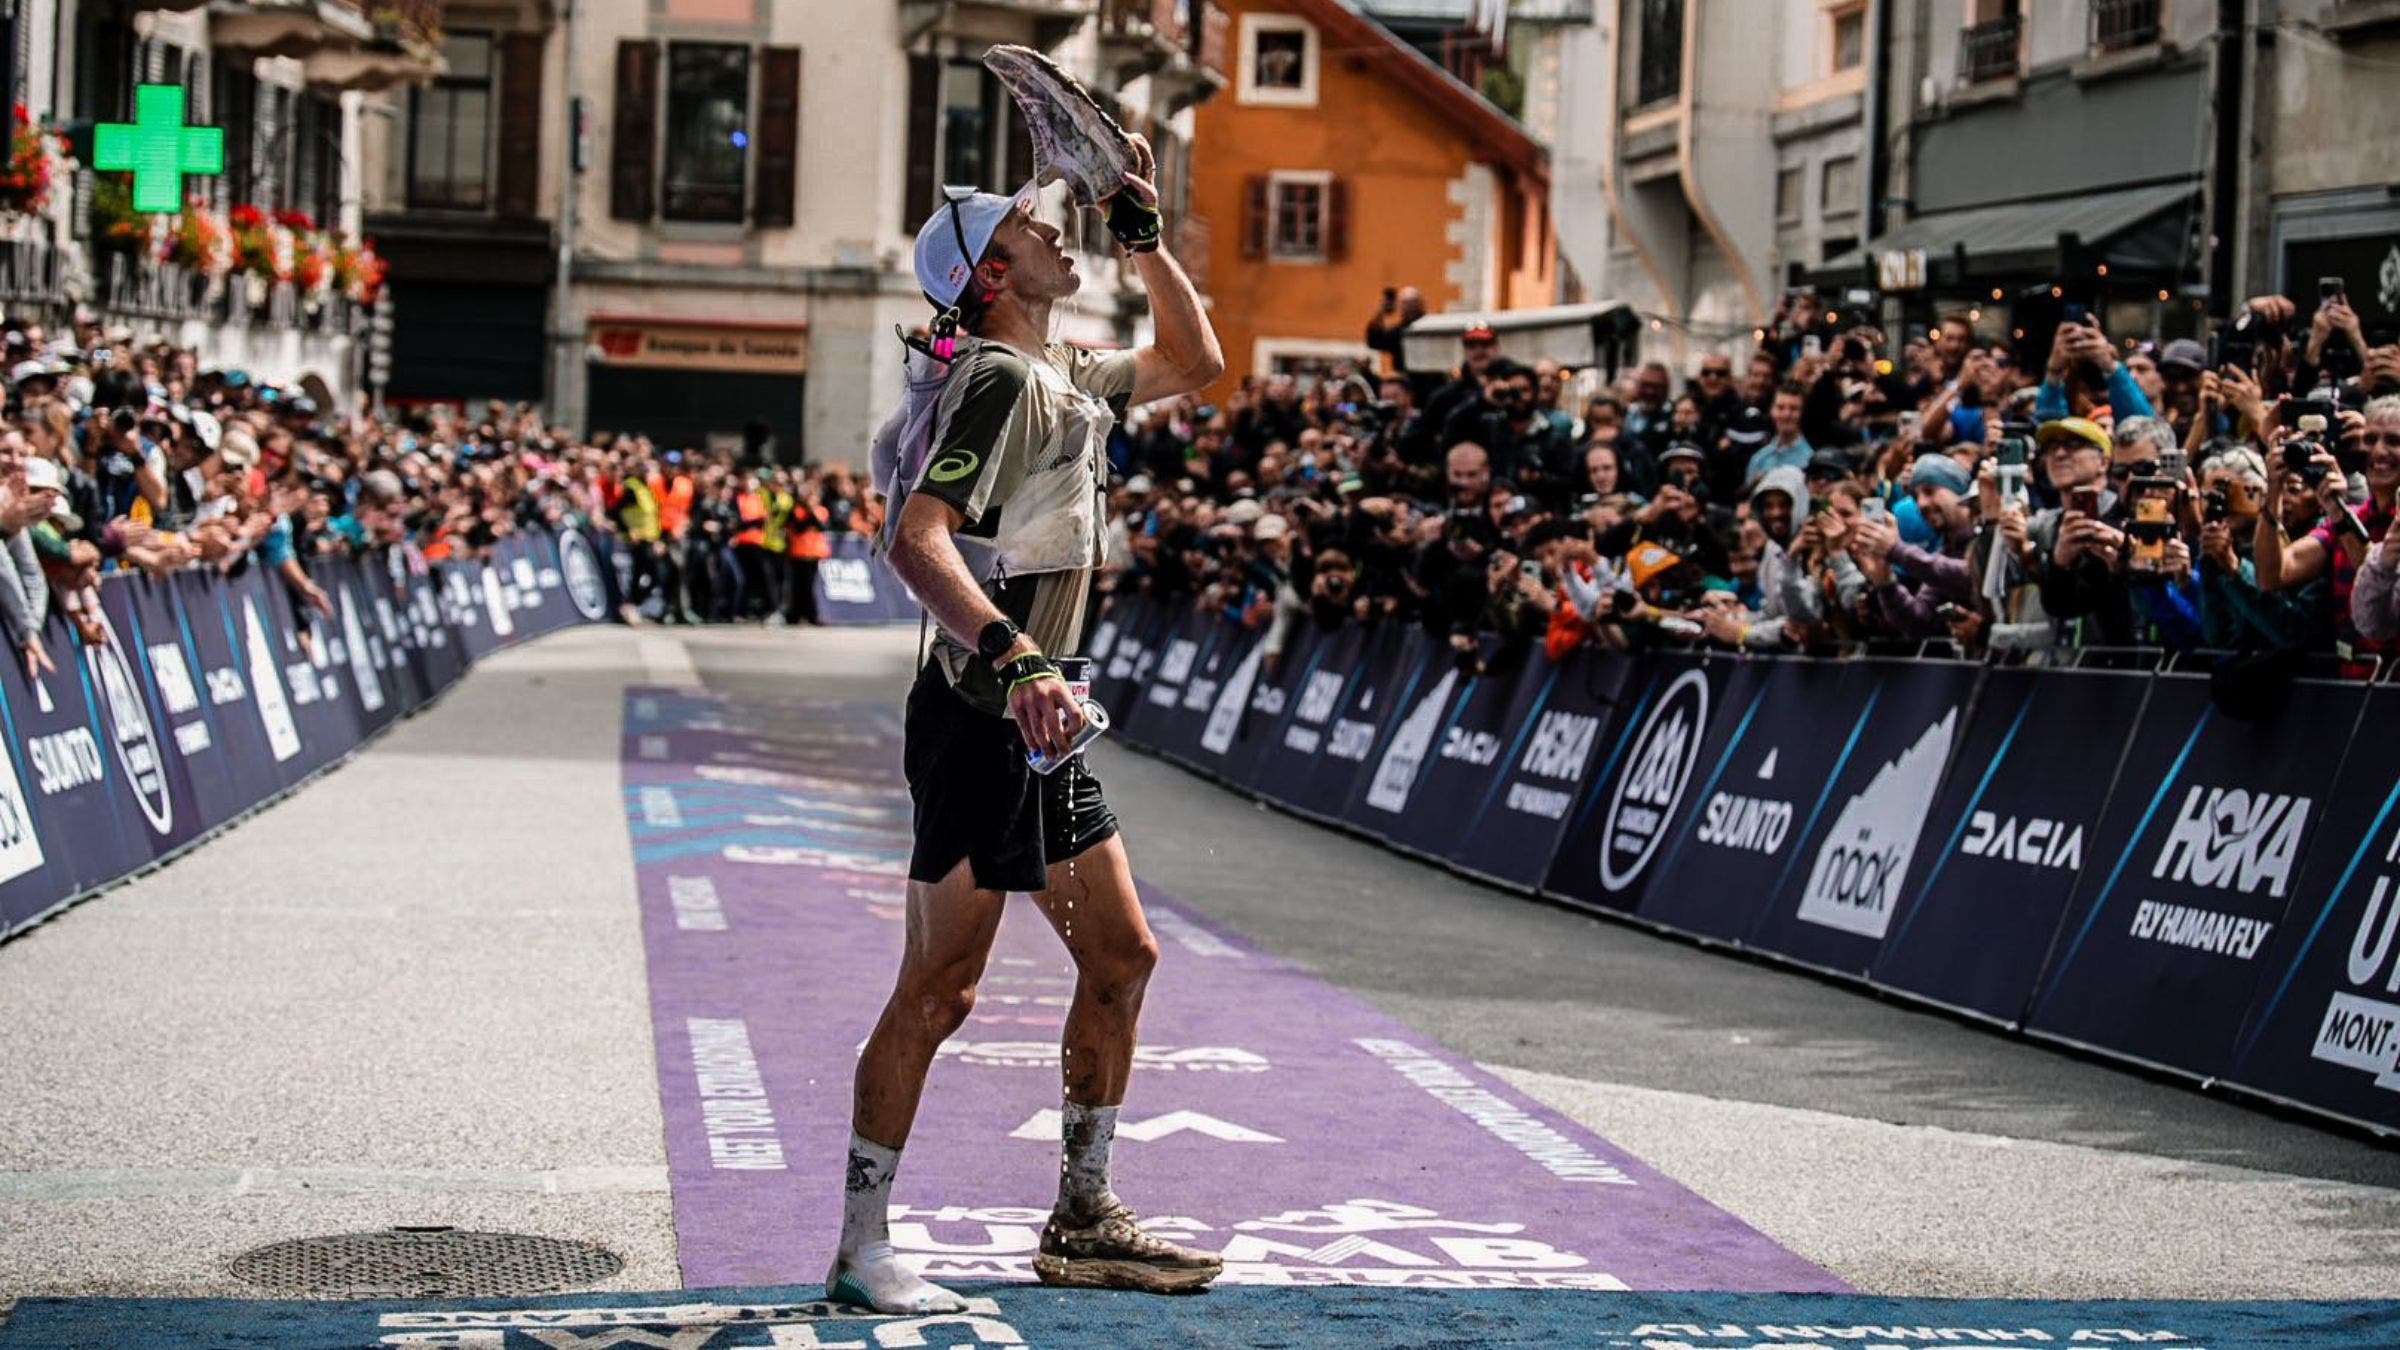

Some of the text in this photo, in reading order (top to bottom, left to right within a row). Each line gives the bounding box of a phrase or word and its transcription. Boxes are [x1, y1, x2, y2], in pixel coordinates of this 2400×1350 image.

[28, 727, 104, 795] SUUNTO
[1697, 791, 1794, 855] SUUNTO
[1961, 810, 2084, 871] DACIA
[2152, 785, 2313, 898] HOKA
[1818, 828, 1903, 912] nöök
[2129, 899, 2273, 960] FLY HUMAN FLY
[888, 1204, 1213, 1232] HOA
[888, 1222, 1590, 1268] UMB
